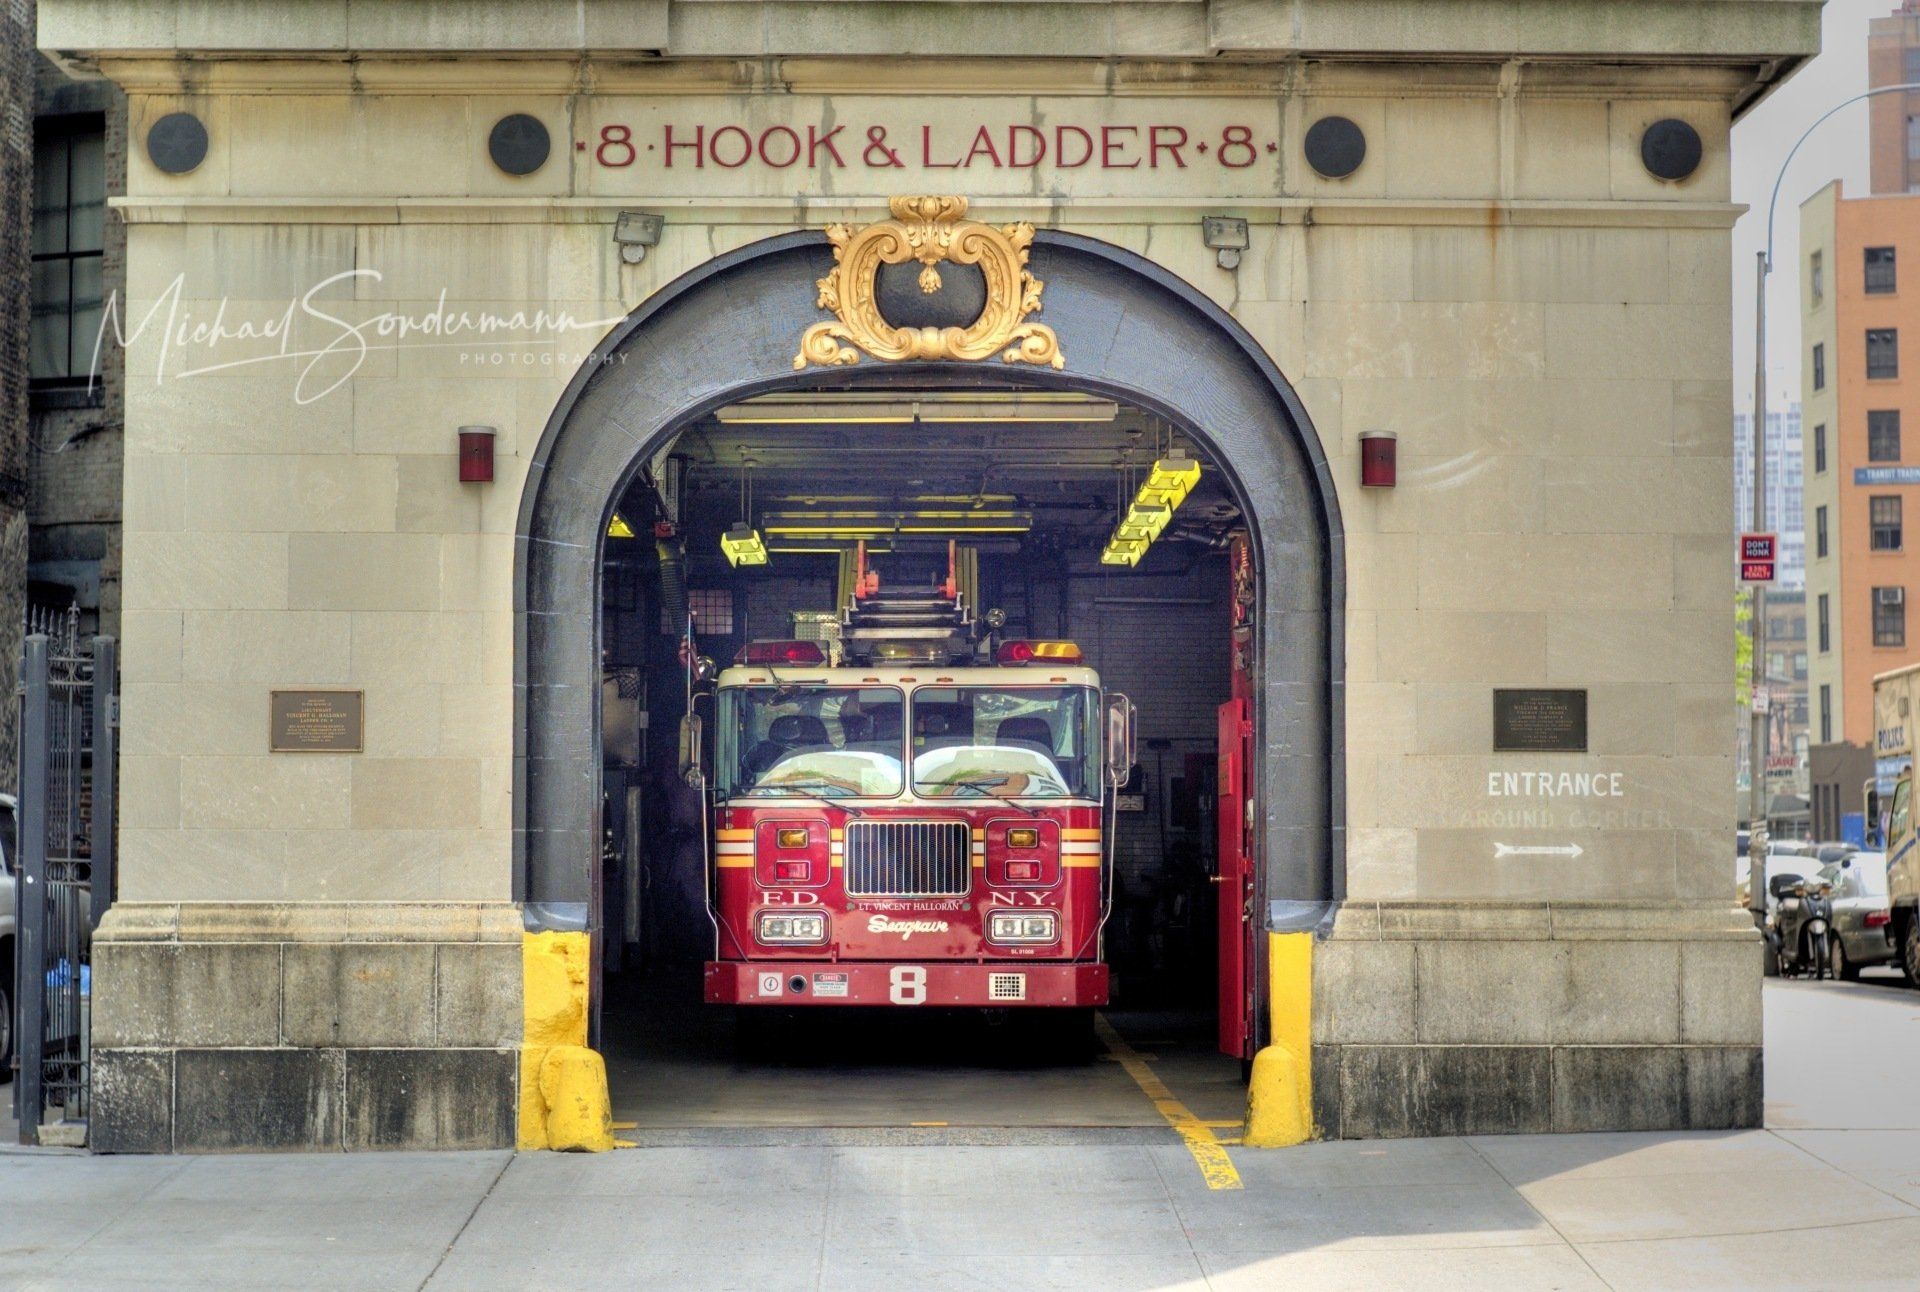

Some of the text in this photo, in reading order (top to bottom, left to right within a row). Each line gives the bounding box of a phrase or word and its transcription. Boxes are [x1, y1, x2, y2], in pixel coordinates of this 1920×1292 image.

[862, 124, 906, 169] &
[1746, 540, 1770, 549] DON'T
[1746, 549, 1770, 557] HONK
[1878, 726, 1904, 749] POLICE
[1488, 772, 1624, 796] ENTRANCE
[859, 902, 960, 911] LT. VINCENT HALLORAN
[989, 891, 1057, 906] N.Y.
[867, 913, 950, 941] Seagrave
[889, 965, 927, 1005] 8
